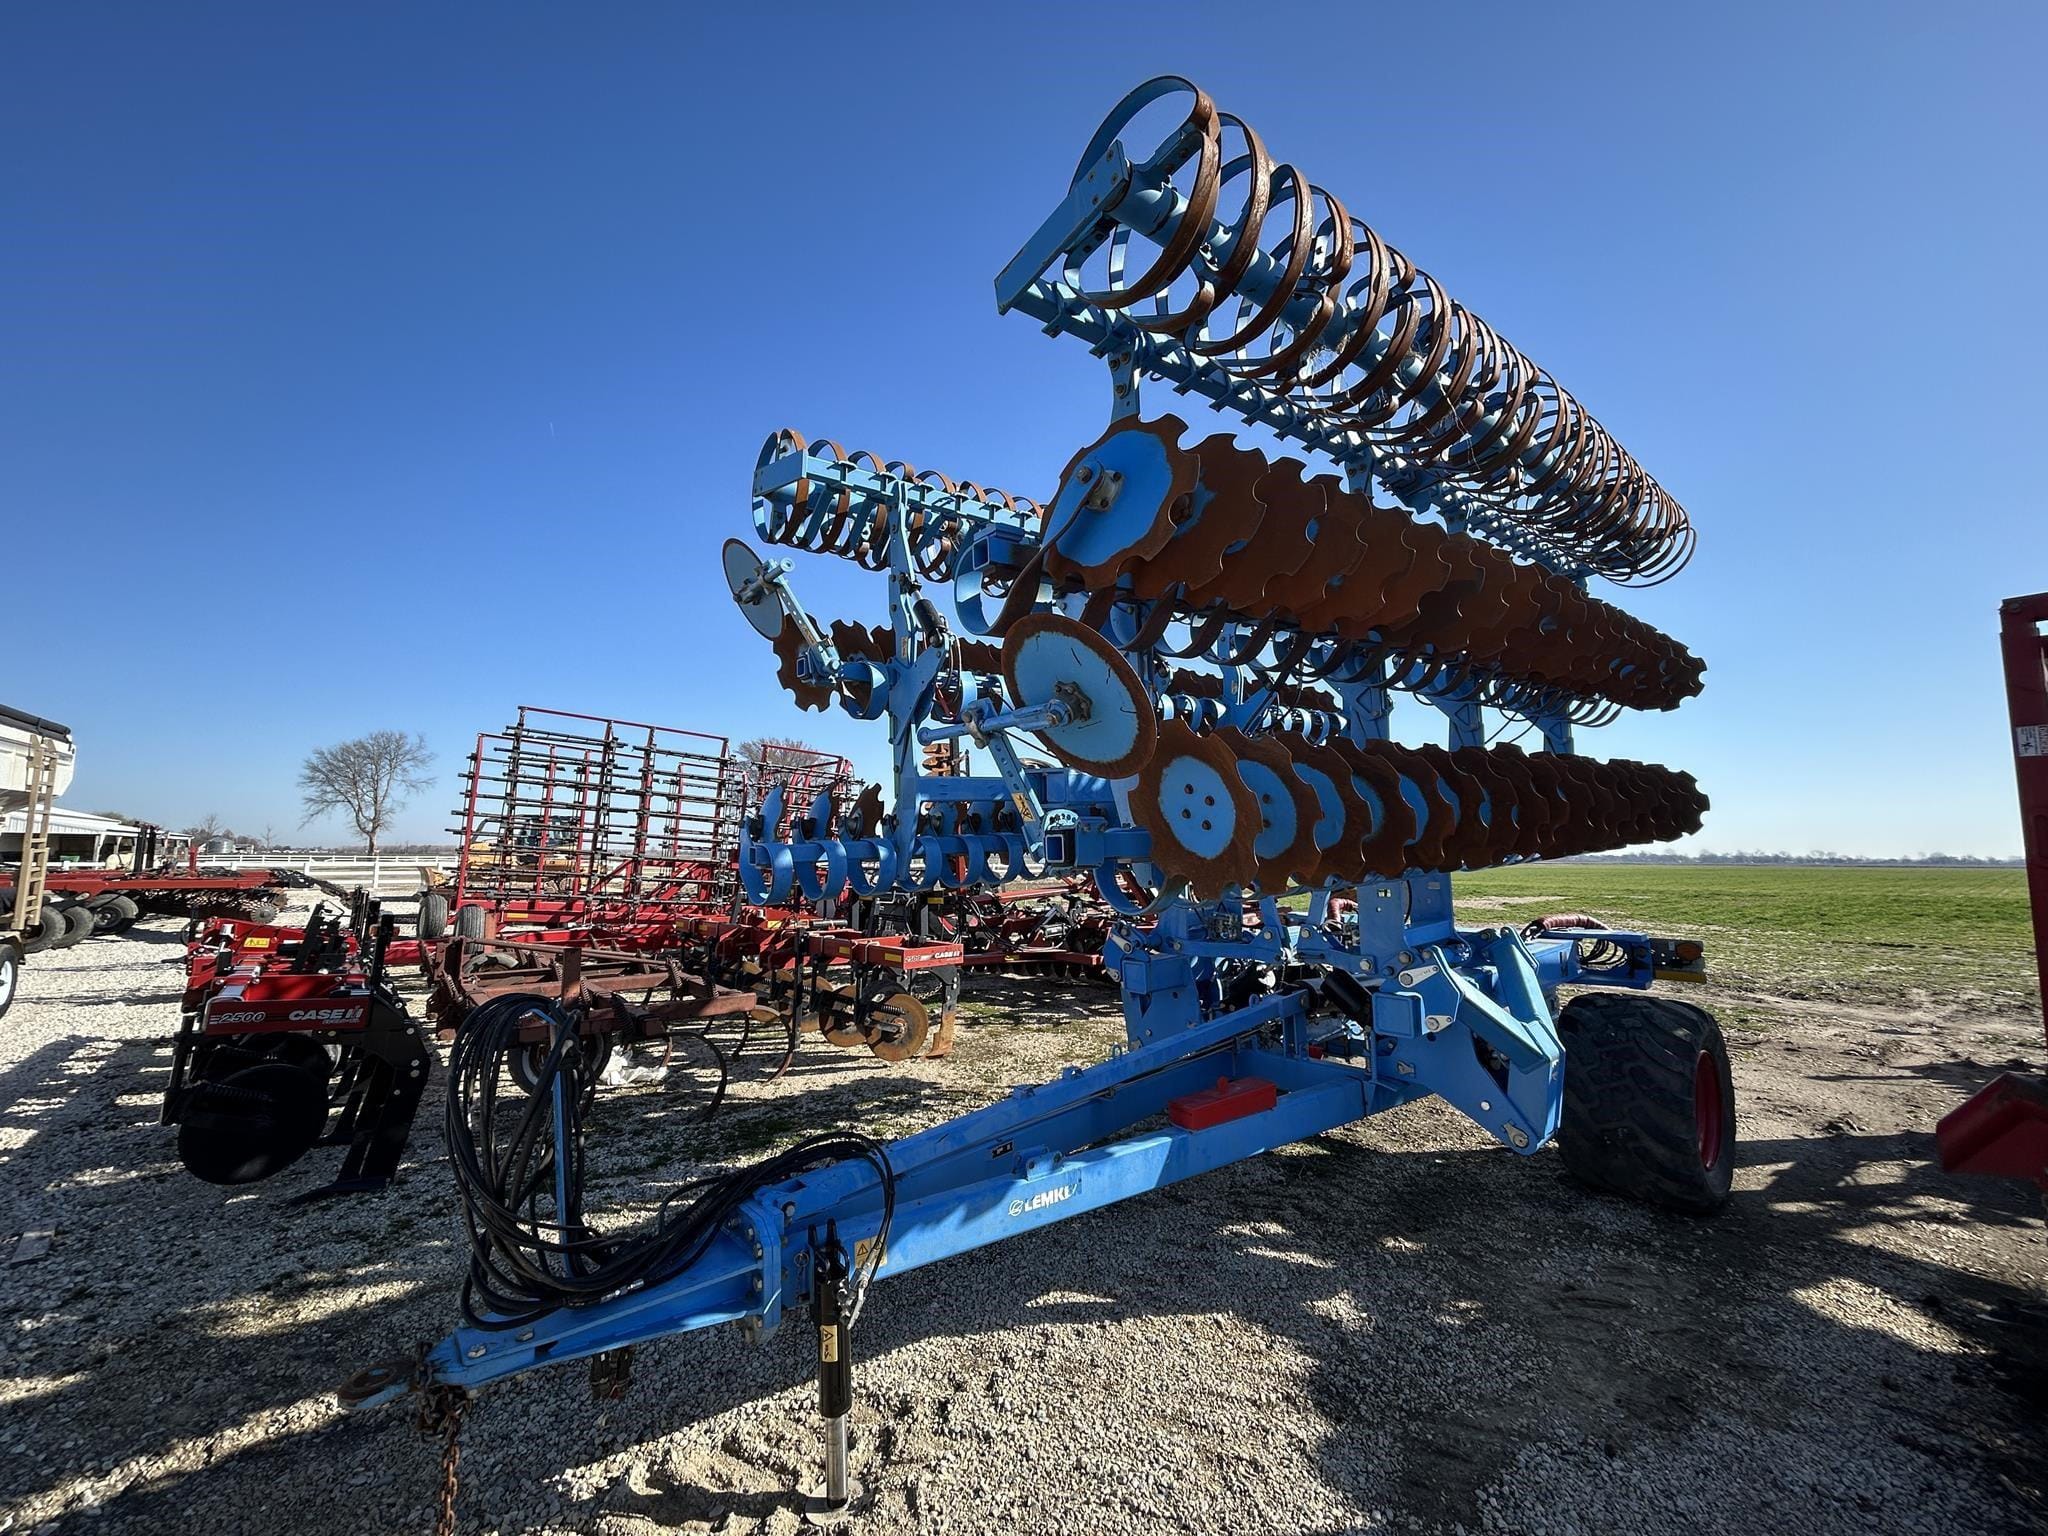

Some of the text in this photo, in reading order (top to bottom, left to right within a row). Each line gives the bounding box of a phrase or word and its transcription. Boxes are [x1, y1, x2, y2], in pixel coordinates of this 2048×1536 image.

[219, 1011, 267, 1024] 2500
[288, 1008, 345, 1021] CASE
[1024, 1183, 1078, 1212] LEMK
